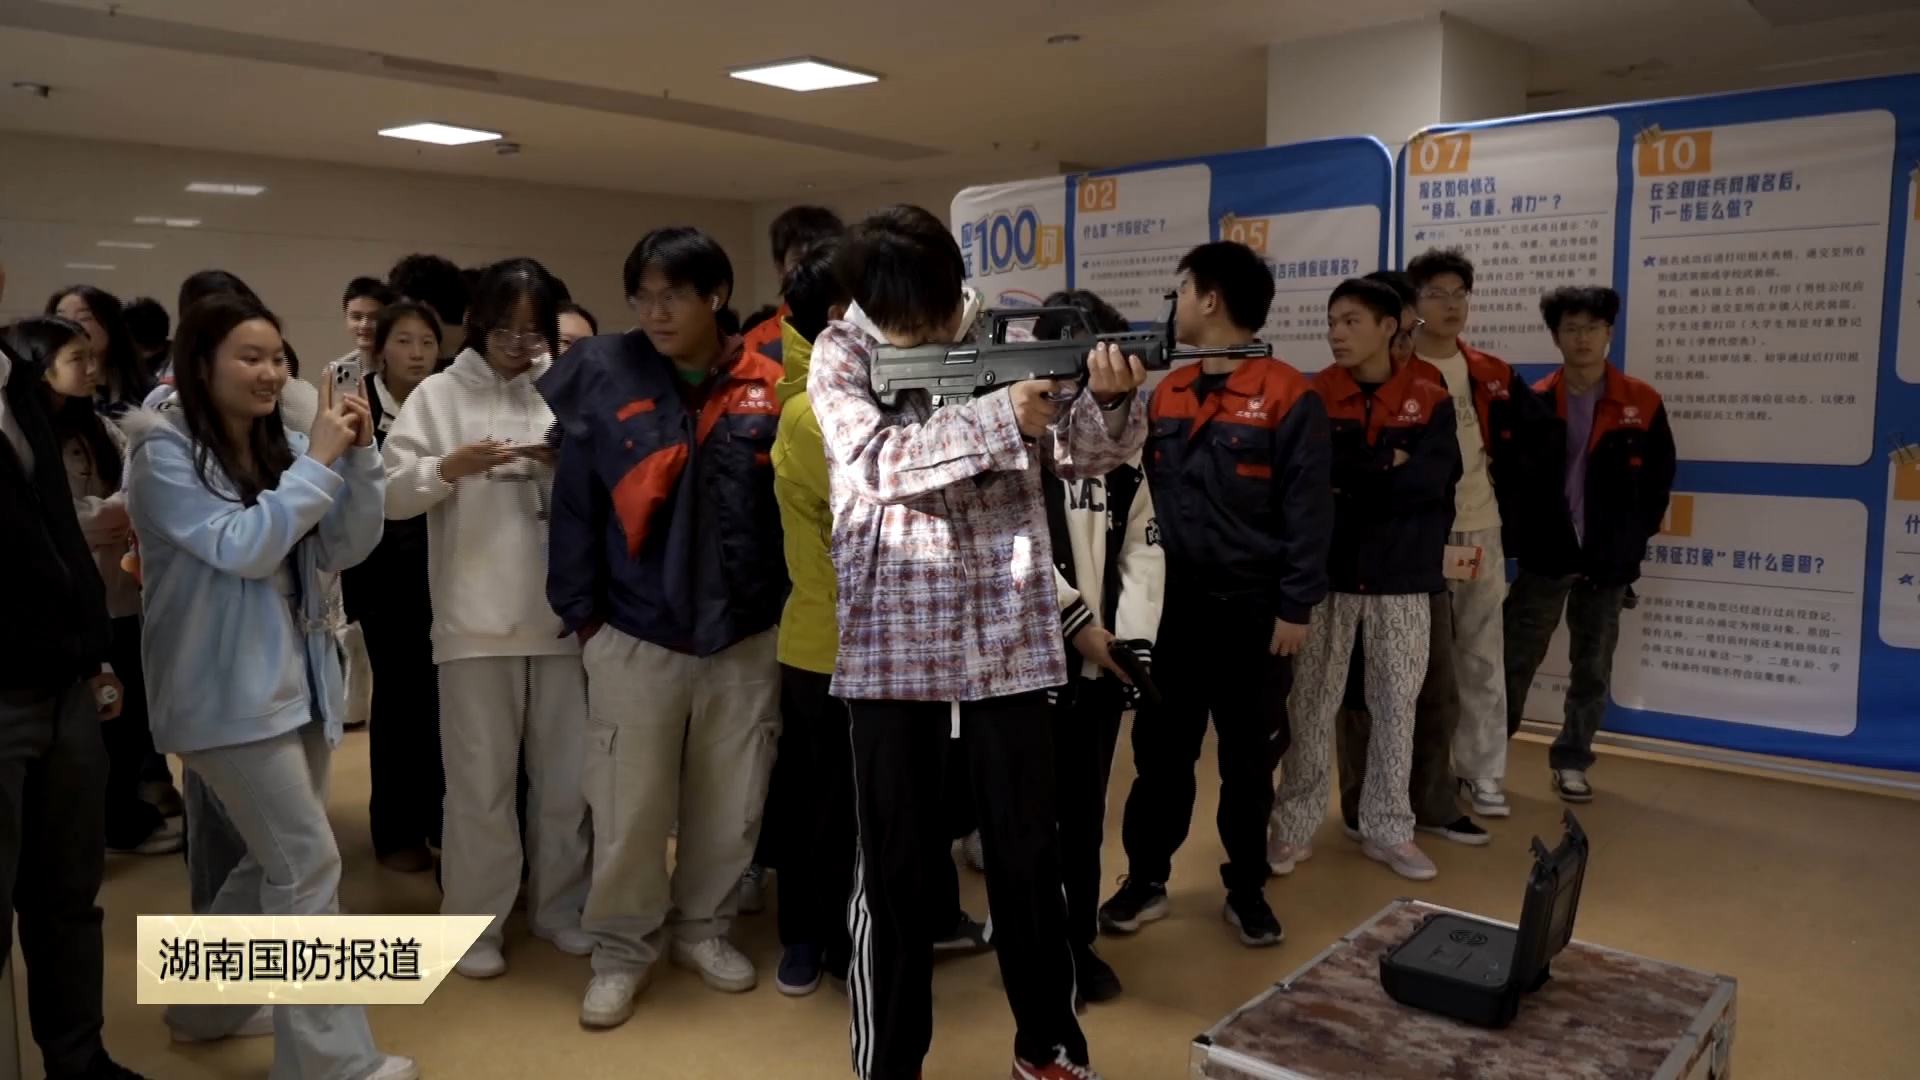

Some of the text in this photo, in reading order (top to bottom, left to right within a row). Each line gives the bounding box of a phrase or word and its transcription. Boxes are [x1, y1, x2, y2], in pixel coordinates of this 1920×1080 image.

[1419, 139, 1463, 171] 07
[1651, 135, 1698, 172] 10
[1083, 181, 1114, 209] 02
[1419, 176, 1497, 200] 报名如何修改
